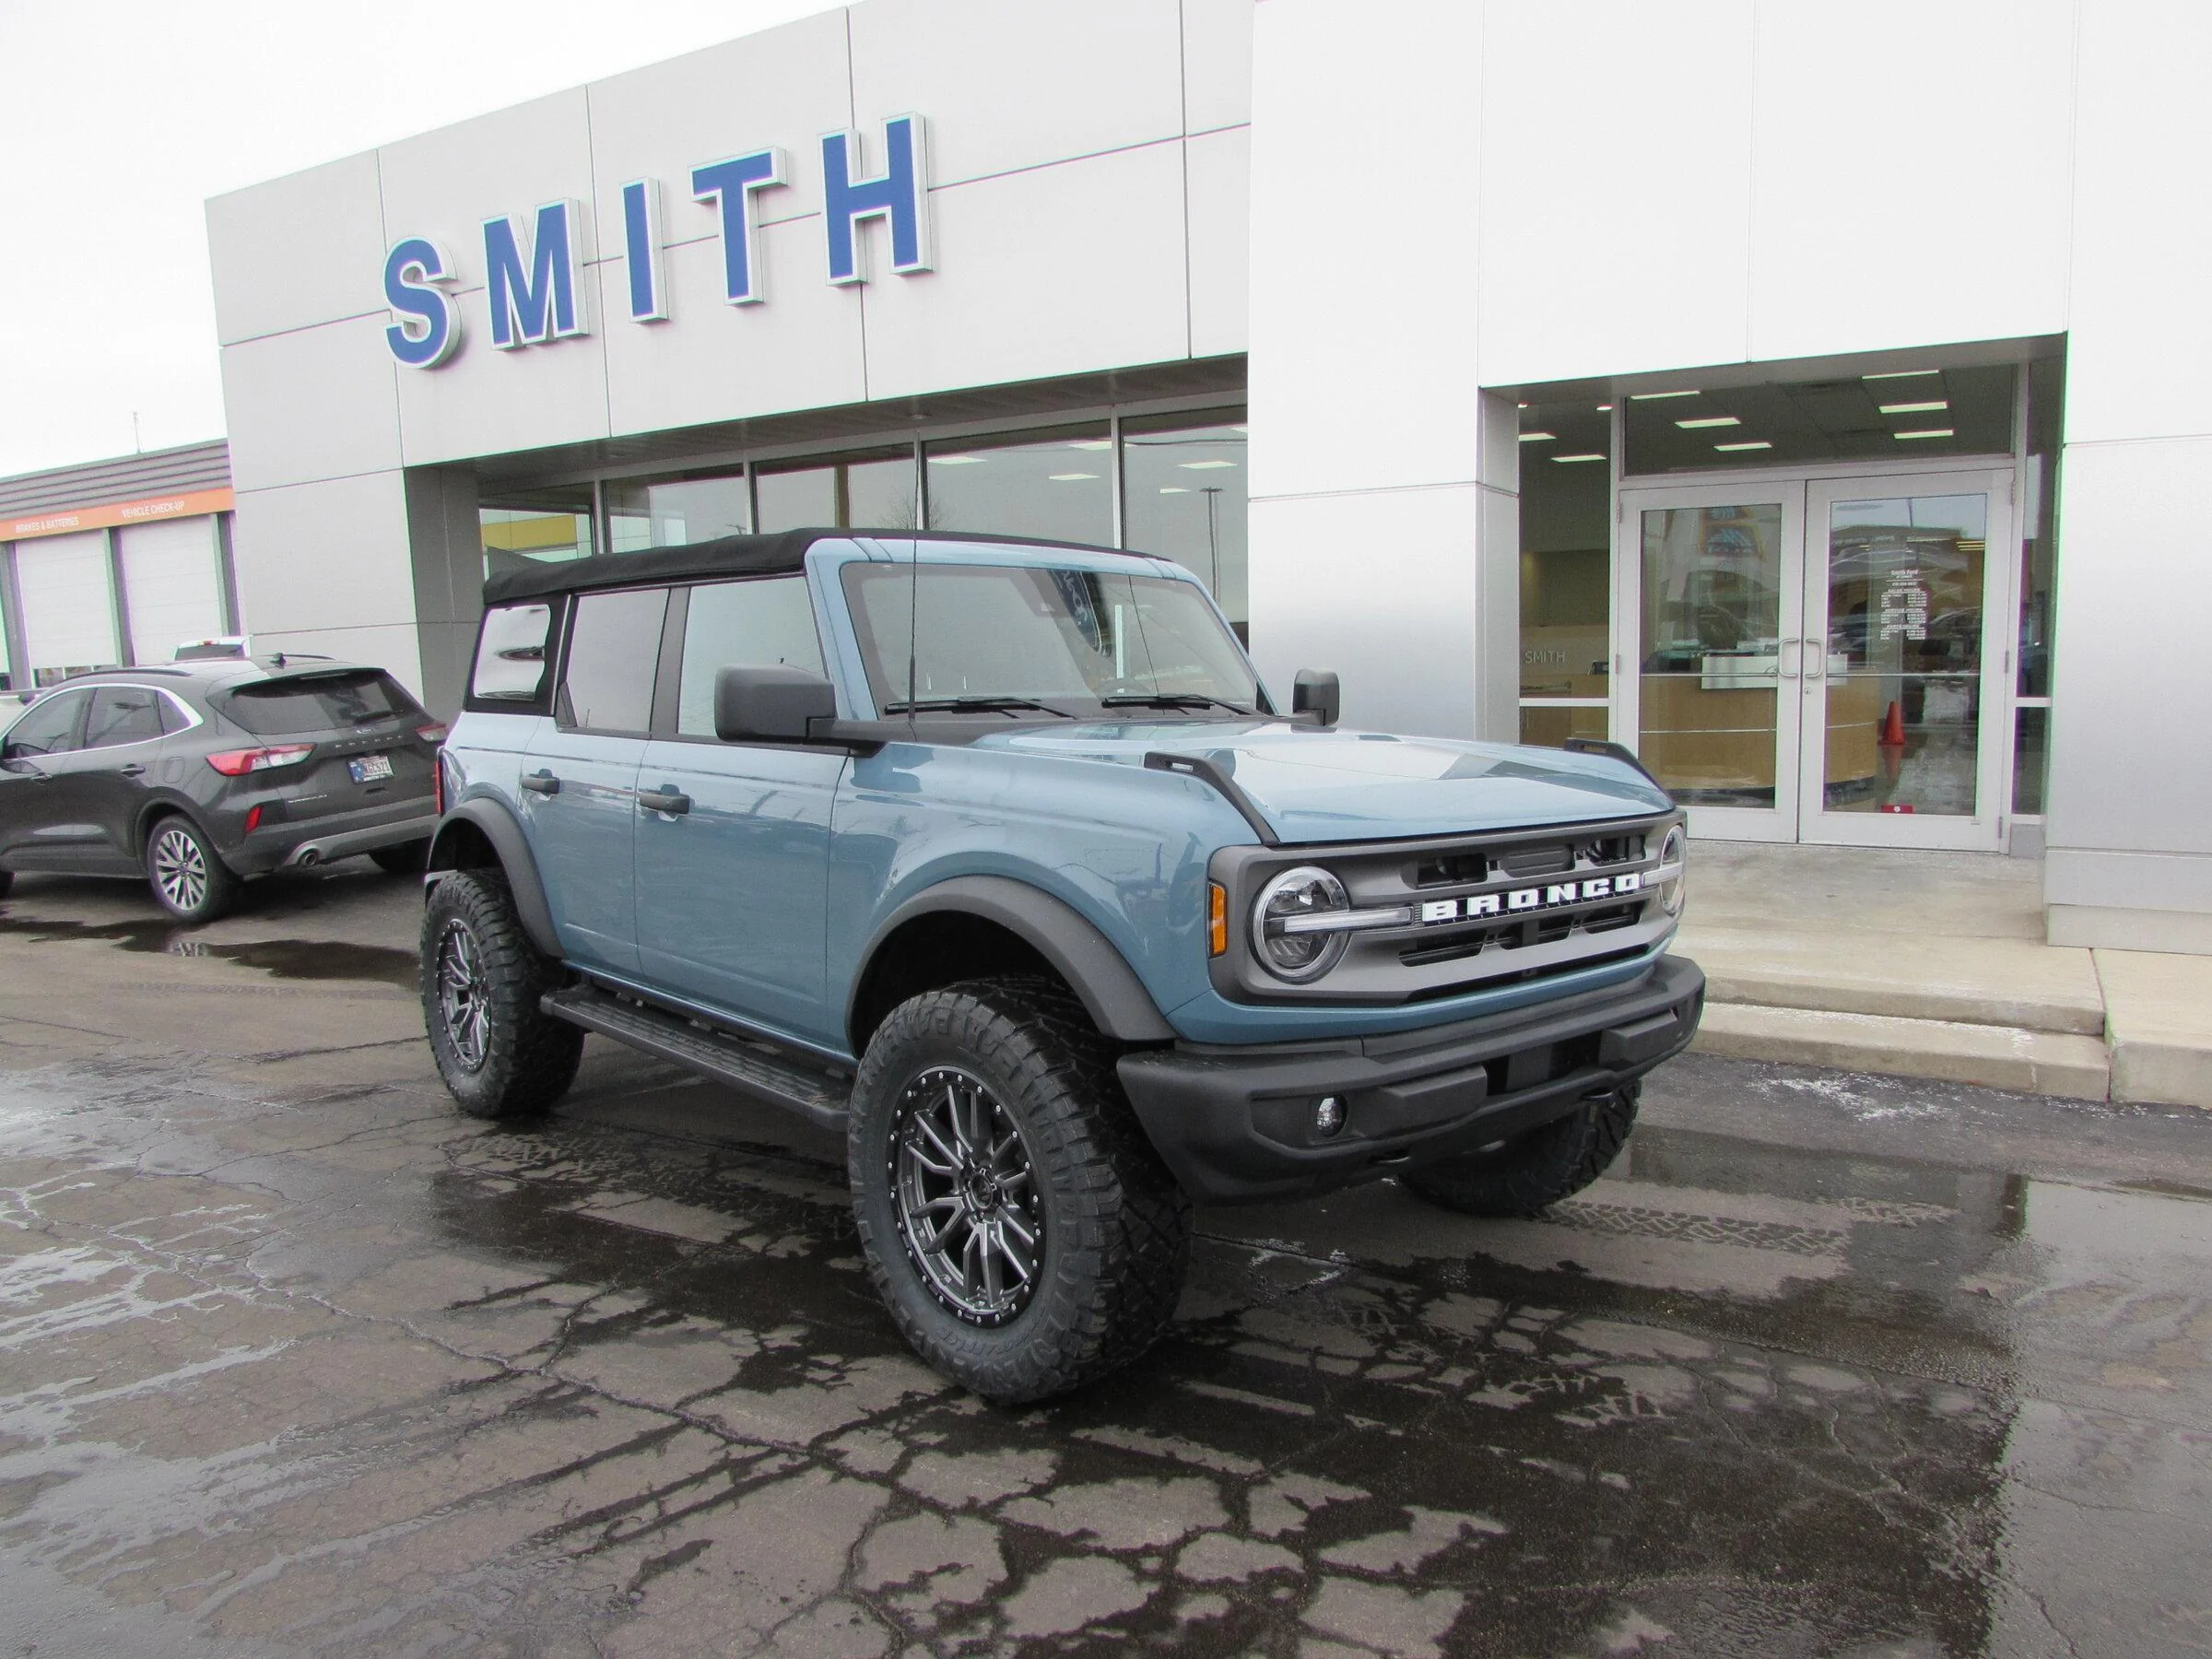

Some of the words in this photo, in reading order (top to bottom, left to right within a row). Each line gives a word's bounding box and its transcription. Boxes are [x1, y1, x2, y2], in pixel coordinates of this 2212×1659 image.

[383, 112, 933, 369] SMITH
[122, 506, 149, 519] VEHICLE
[150, 500, 185, 516] CHECK-UP
[1524, 650, 1565, 664] SMITH
[1422, 874, 1640, 922] BRONCO
